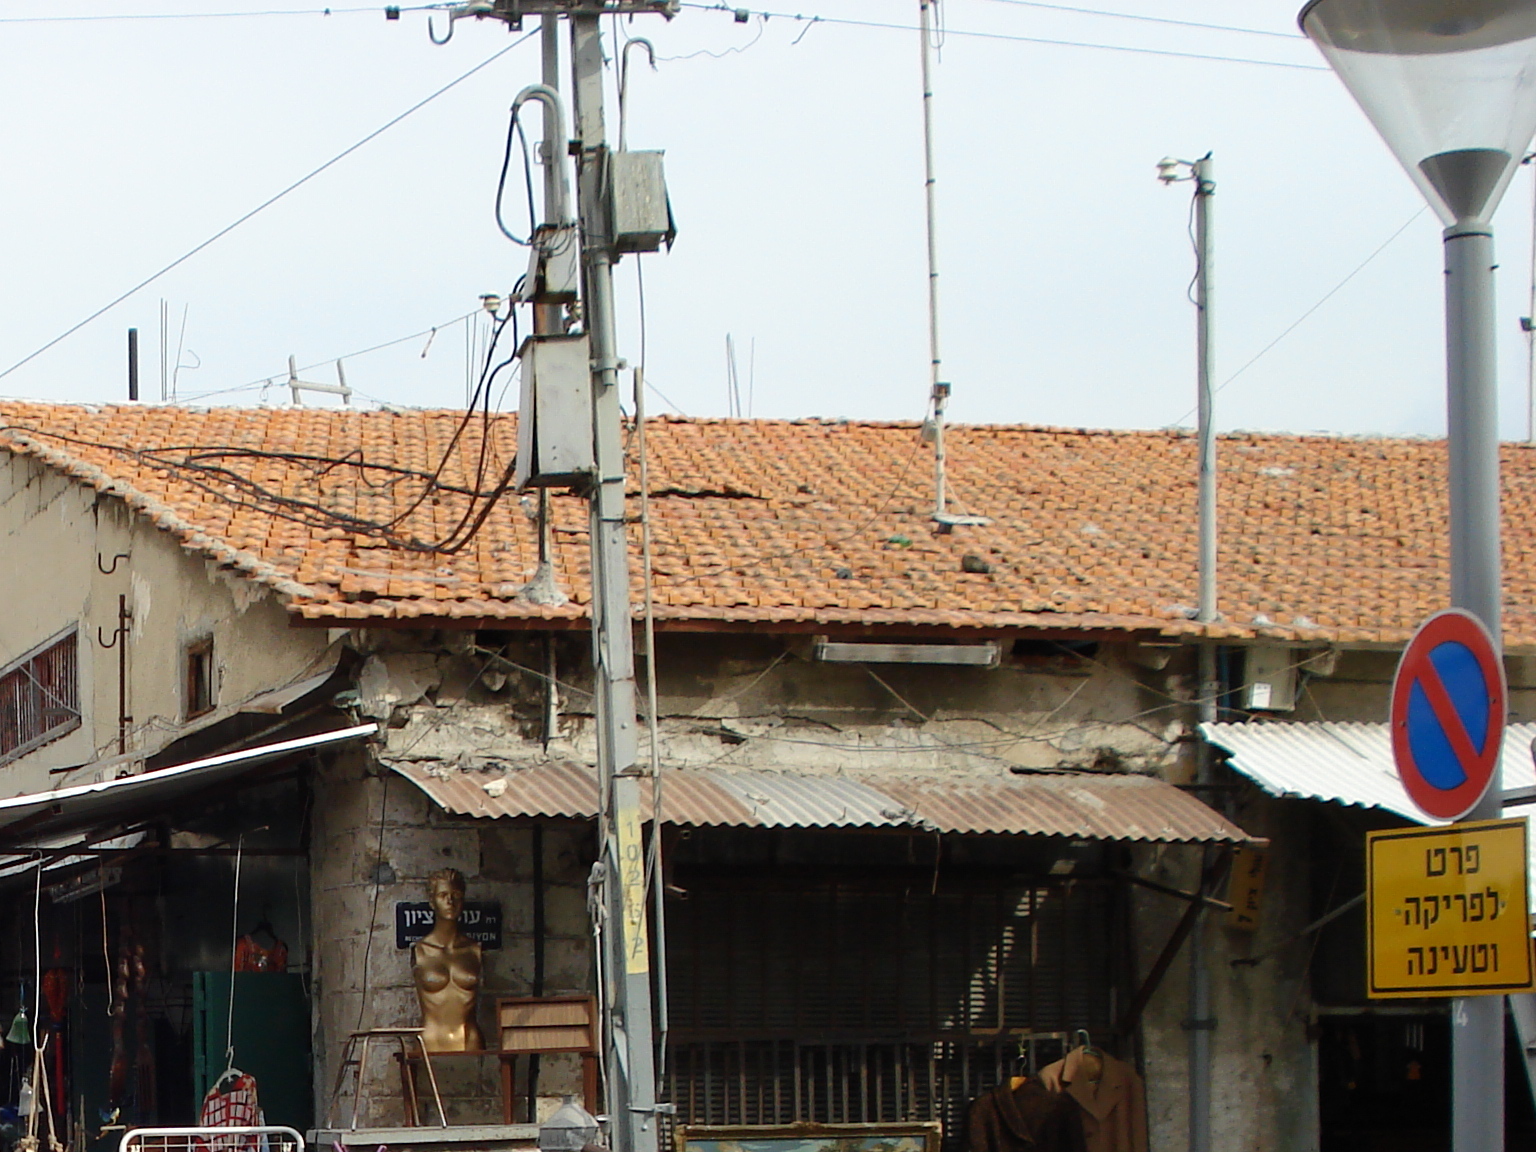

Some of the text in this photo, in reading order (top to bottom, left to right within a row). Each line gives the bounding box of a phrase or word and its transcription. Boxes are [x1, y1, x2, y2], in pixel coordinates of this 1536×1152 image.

[1426, 844, 1480, 877] פרט
[1405, 886, 1500, 930] לפריקה
[1408, 943, 1499, 976] וטעינה
